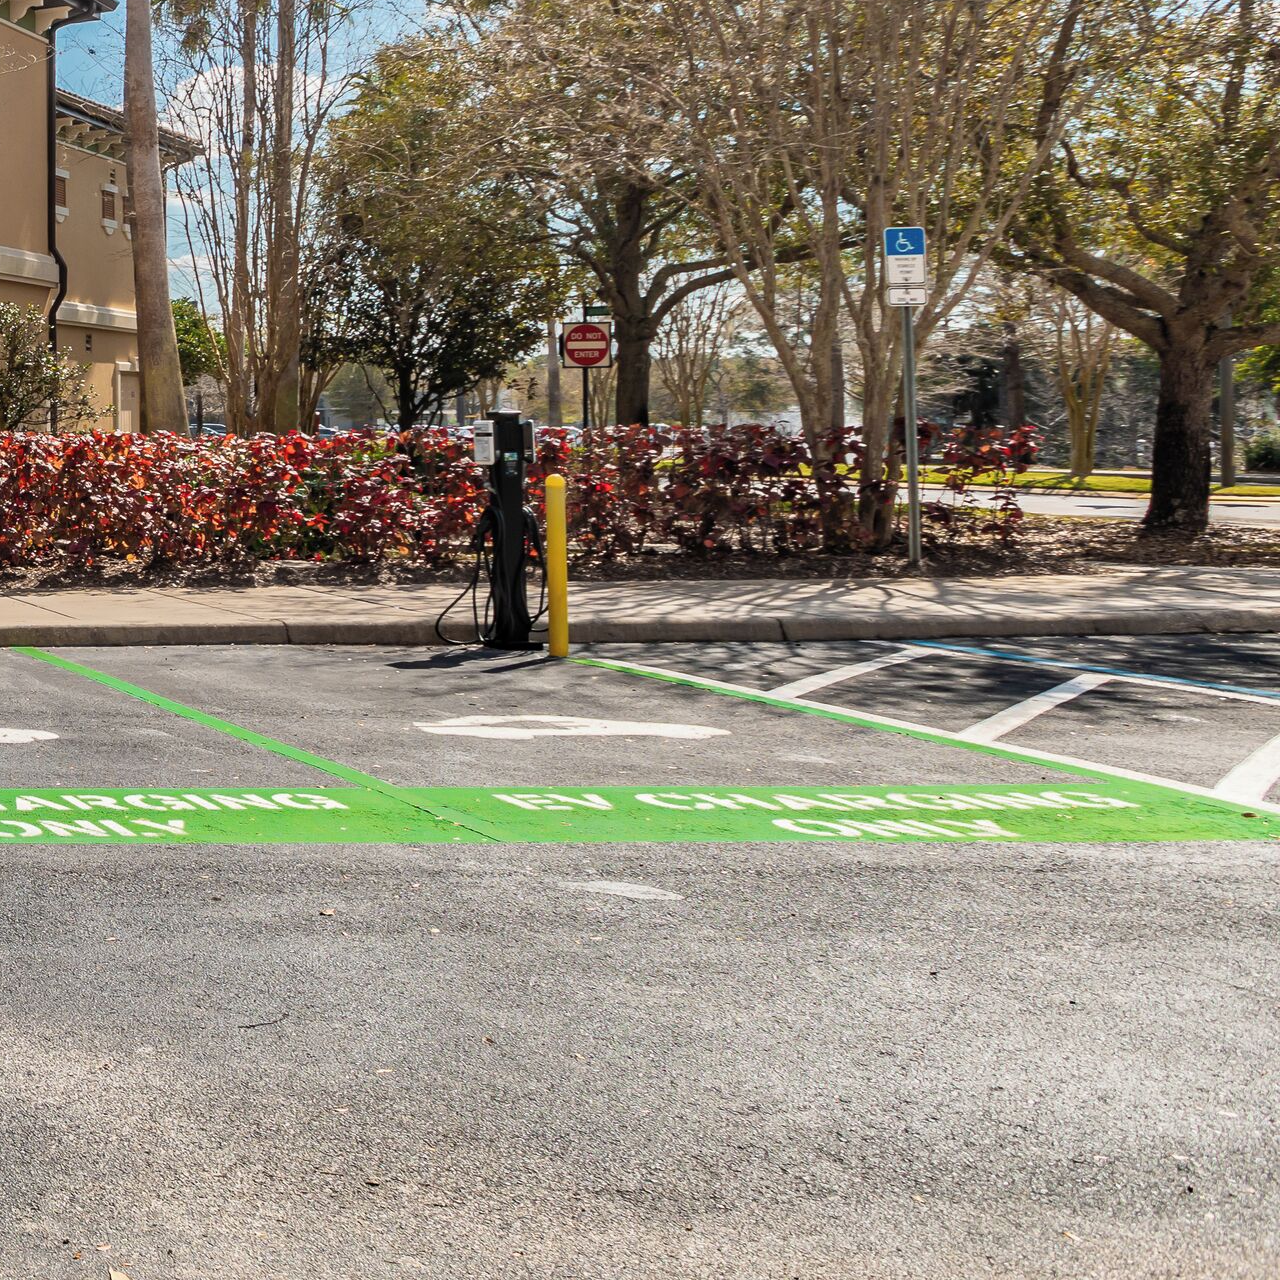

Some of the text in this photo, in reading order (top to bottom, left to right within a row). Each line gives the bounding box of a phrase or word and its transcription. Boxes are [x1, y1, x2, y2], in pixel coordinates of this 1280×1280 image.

[492, 791, 1141, 811] EV CHARGING
[772, 818, 1020, 837] ONLY
